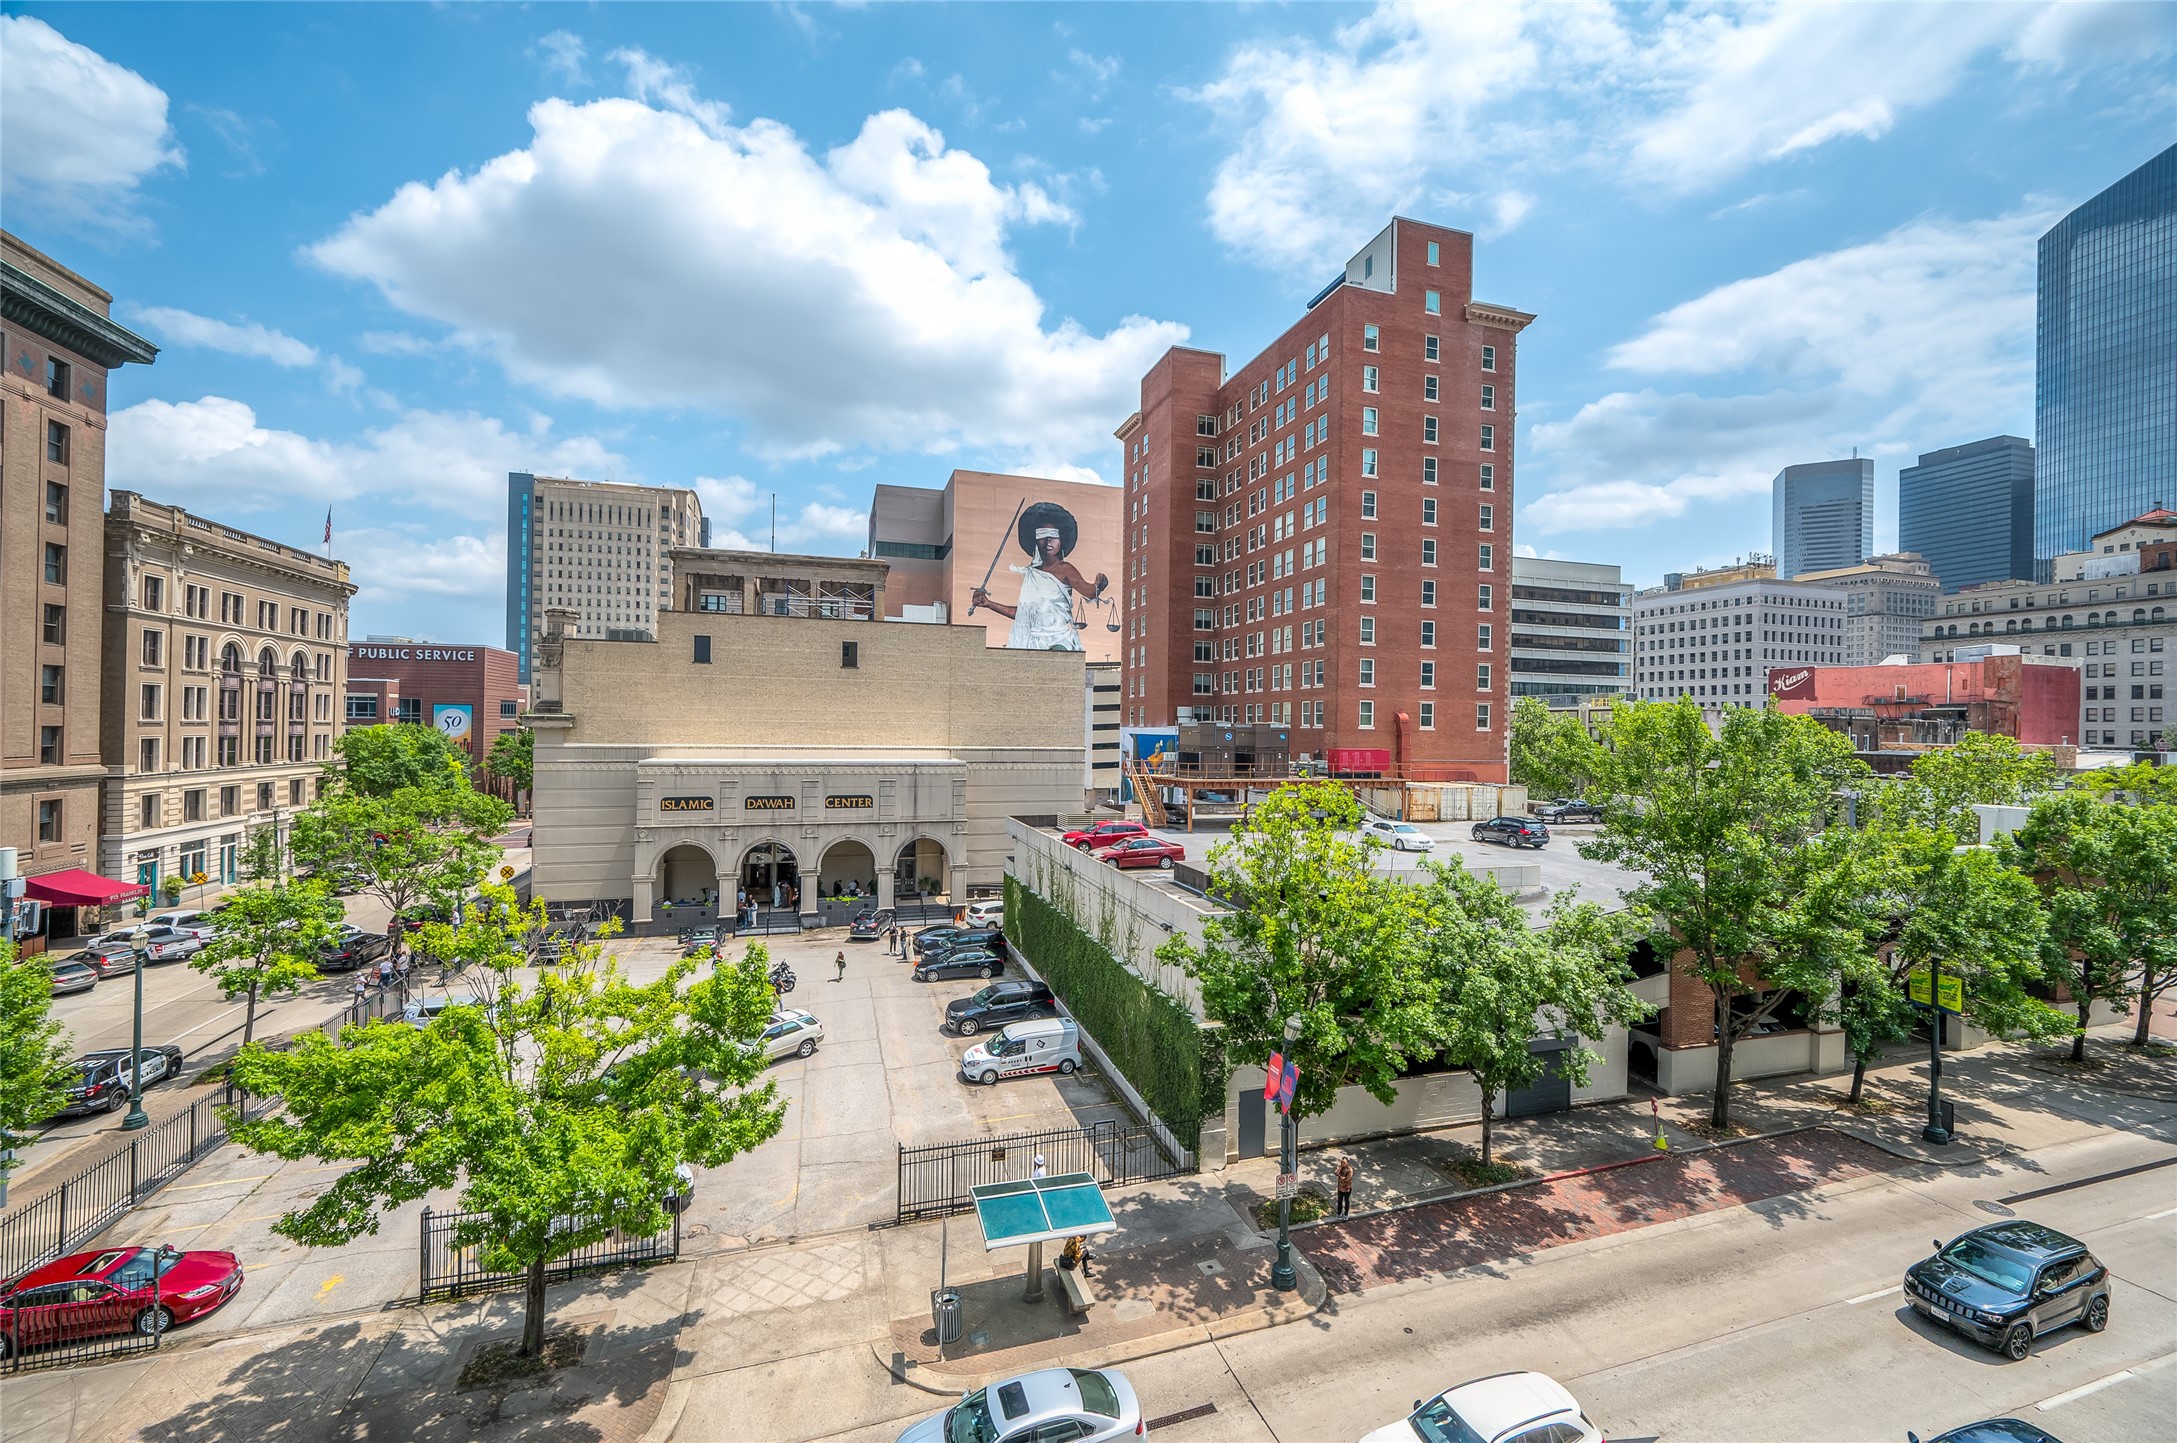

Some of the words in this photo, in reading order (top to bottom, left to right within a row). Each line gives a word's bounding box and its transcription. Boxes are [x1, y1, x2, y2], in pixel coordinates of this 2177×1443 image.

[358, 647, 410, 660] PUBLIC
[416, 648, 475, 661] SERVICE
[1773, 670, 1812, 691] Kiam
[443, 715, 462, 731] 50
[661, 799, 713, 810] ISLAMIC
[746, 798, 794, 809] DA'WAH
[825, 797, 873, 809] CENTER
[120, 888, 143, 898] FRANKLIN
[127, 1067, 162, 1085] PLICE
